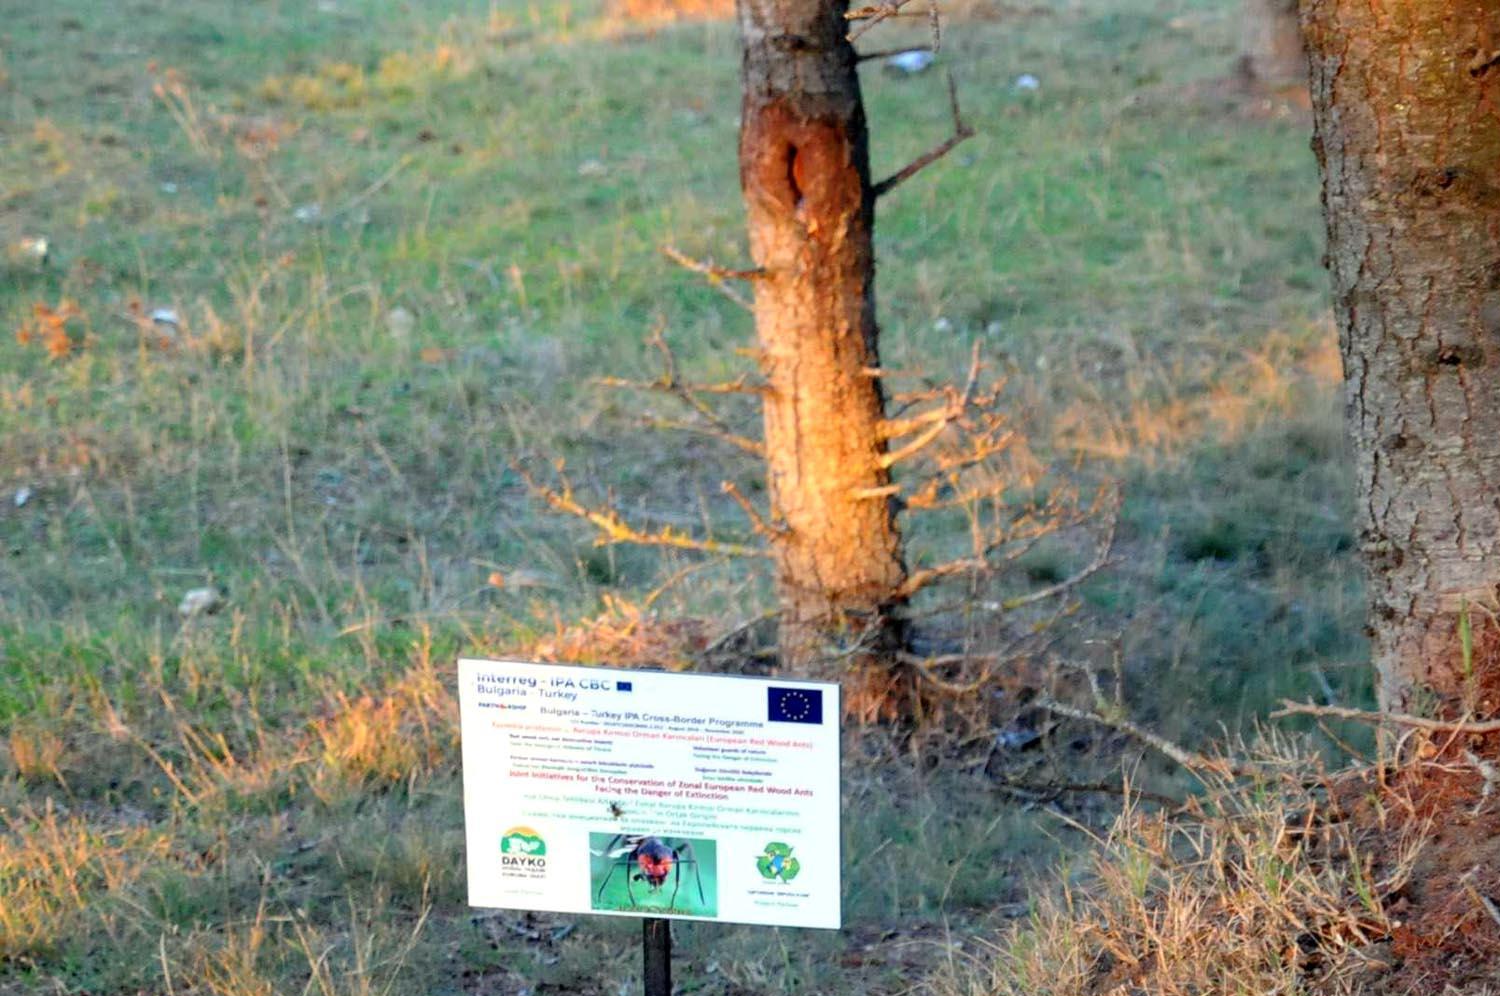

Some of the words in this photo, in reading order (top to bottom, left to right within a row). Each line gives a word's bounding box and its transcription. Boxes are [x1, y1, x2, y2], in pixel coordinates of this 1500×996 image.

[550, 677, 575, 688] IPA
[579, 680, 611, 691] CBC
[477, 685, 527, 697] Bulgaria
[538, 689, 577, 701] Turkey
[540, 706, 580, 718] Bulgaria
[591, 709, 622, 721] Turkey
[625, 711, 639, 720] IPA
[642, 713, 705, 725] Cross-Border
[709, 717, 763, 729] Programme
[532, 771, 574, 781] Initiatives
[576, 773, 588, 782] for
[592, 774, 605, 783] the
[608, 775, 664, 787] Conservation
[667, 779, 675, 787] of
[678, 780, 702, 789] Zonal
[704, 781, 745, 793] European
[748, 784, 765, 793] Red
[766, 785, 792, 795] Wood
[794, 787, 813, 797] Ants
[595, 785, 622, 796] Facing
[624, 786, 638, 795] the
[641, 787, 671, 799] Danger
[674, 789, 683, 798] of
[685, 790, 728, 801] Extinction
[502, 856, 546, 867] DAYKO
